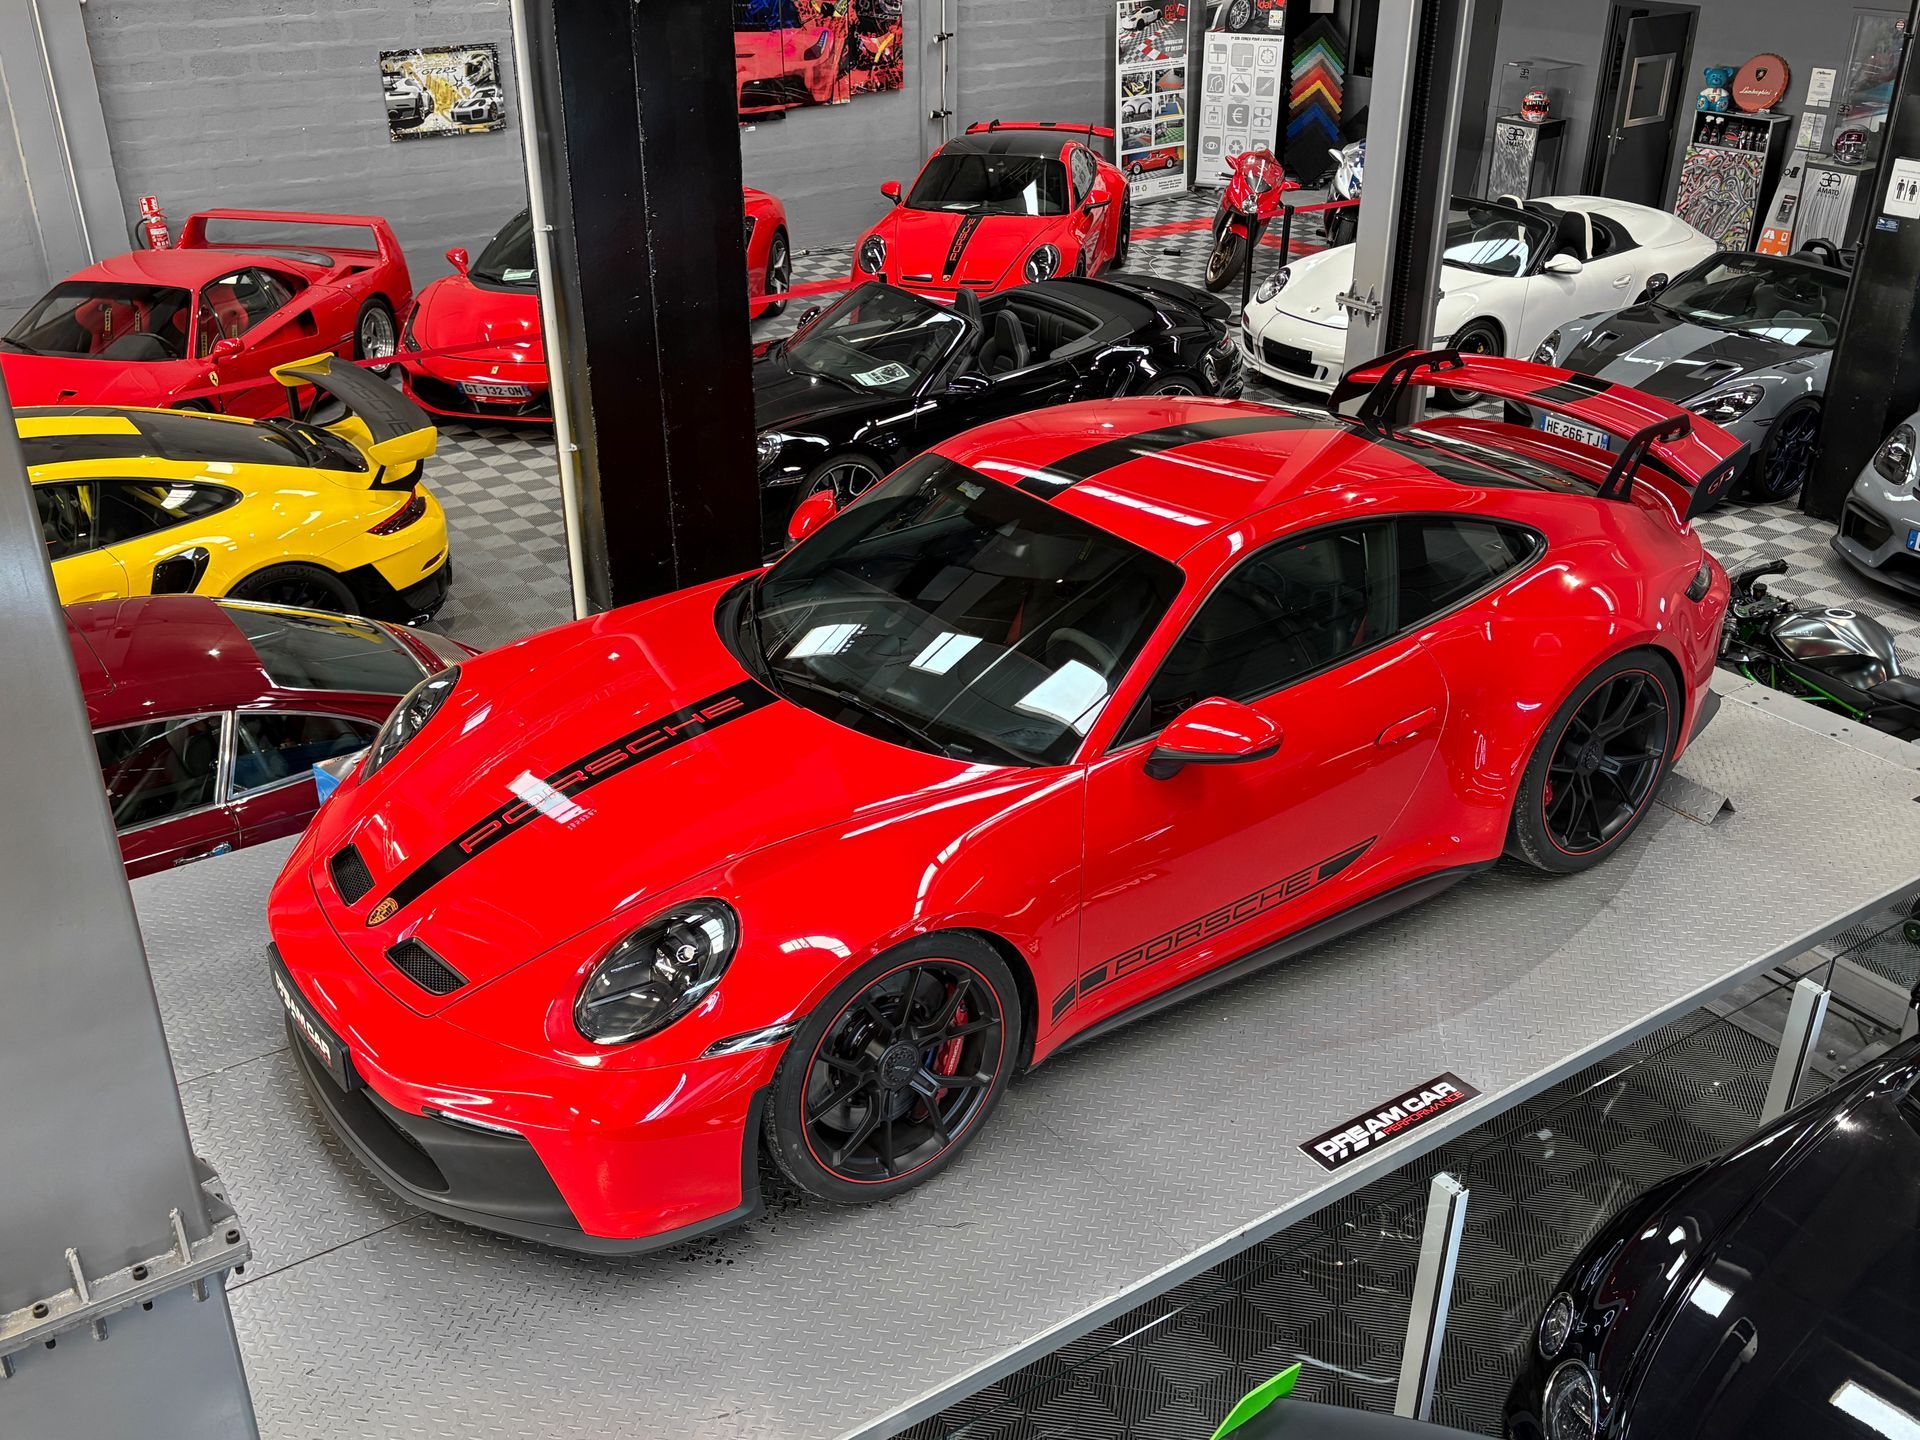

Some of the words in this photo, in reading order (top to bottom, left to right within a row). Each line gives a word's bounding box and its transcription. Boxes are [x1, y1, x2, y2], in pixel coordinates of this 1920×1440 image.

[1816, 187, 1840, 196] AMATO
[949, 218, 977, 262] PORSCHE
[1546, 419, 1601, 447] HE-266-TJ
[1707, 466, 1735, 495] GT3
[459, 696, 744, 853] PORSCHE
[1114, 869, 1314, 976] PORSCHE
[1314, 1105, 1410, 1159] DREAM
[1402, 1081, 1458, 1113] CAR
[1383, 1090, 1465, 1137] PERFORMANCE
